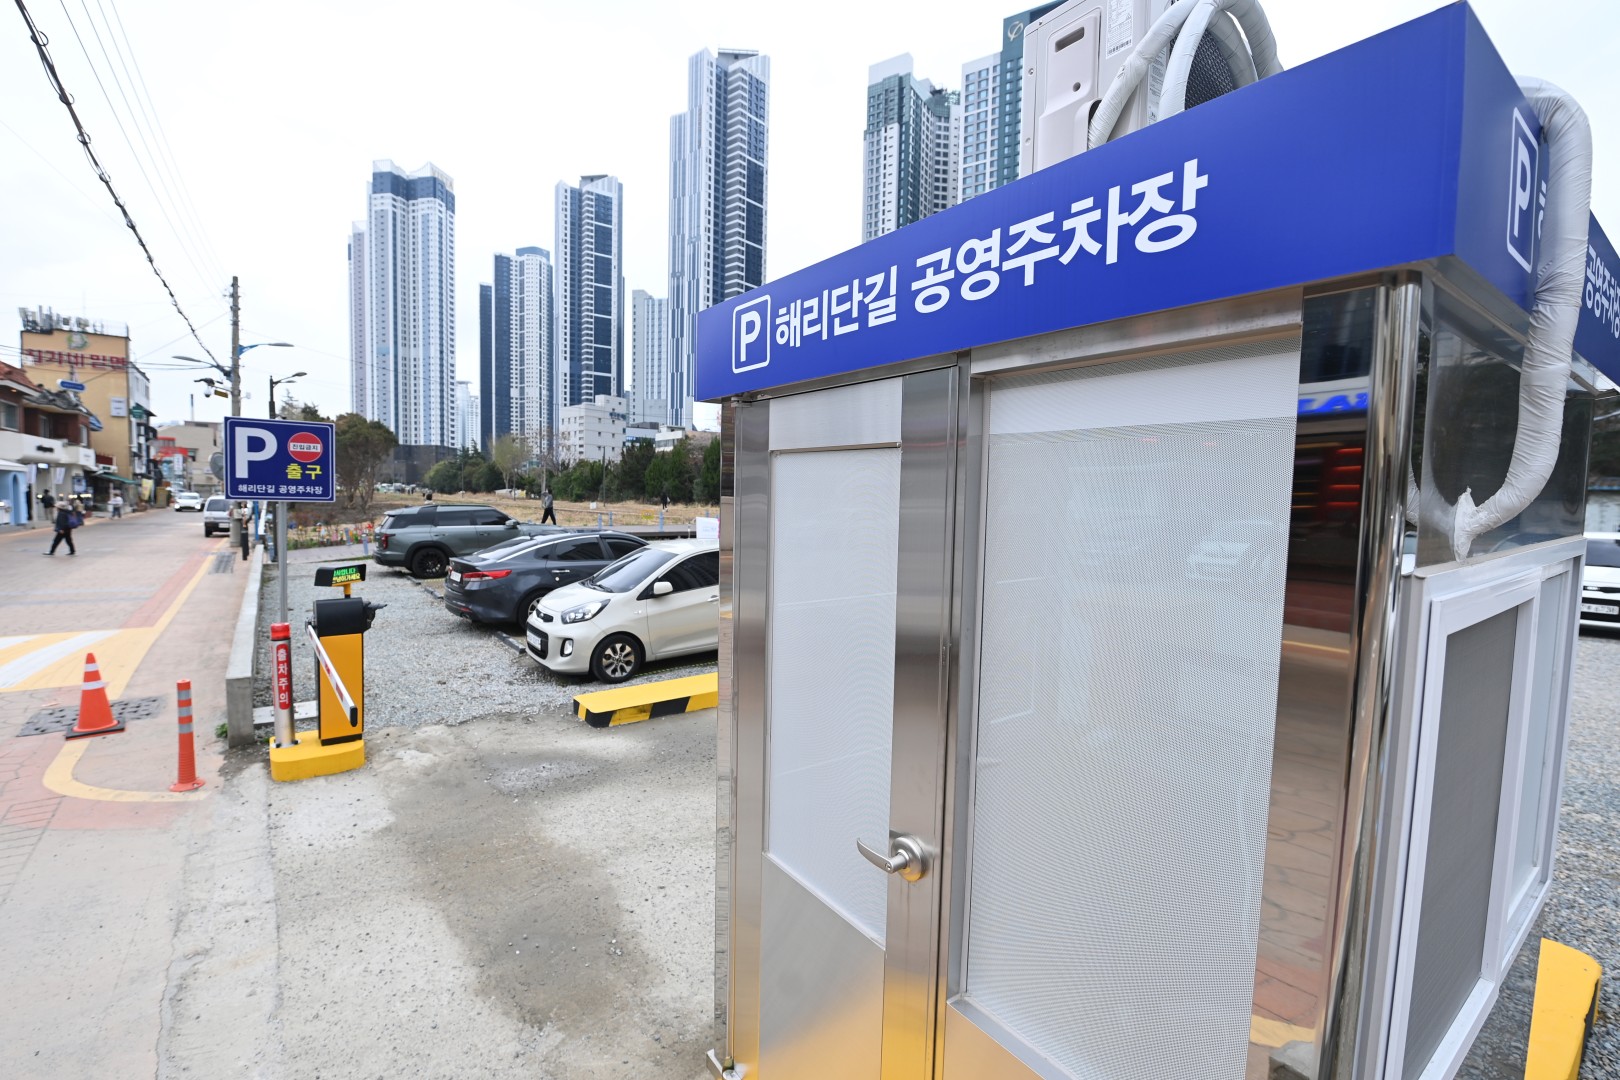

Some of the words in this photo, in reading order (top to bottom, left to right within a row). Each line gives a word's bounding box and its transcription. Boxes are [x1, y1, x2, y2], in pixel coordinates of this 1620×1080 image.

[1513, 136, 1531, 238] P
[740, 308, 761, 363] P
[775, 266, 898, 349] 해리단길
[911, 158, 1209, 314] 공영주차장
[234, 426, 278, 479] P
[285, 463, 322, 480] 출구
[292, 443, 319, 452] 진입금지
[237, 484, 275, 494] 해리단길
[279, 485, 323, 495] 공영주차장
[277, 648, 289, 705] 출차주의
